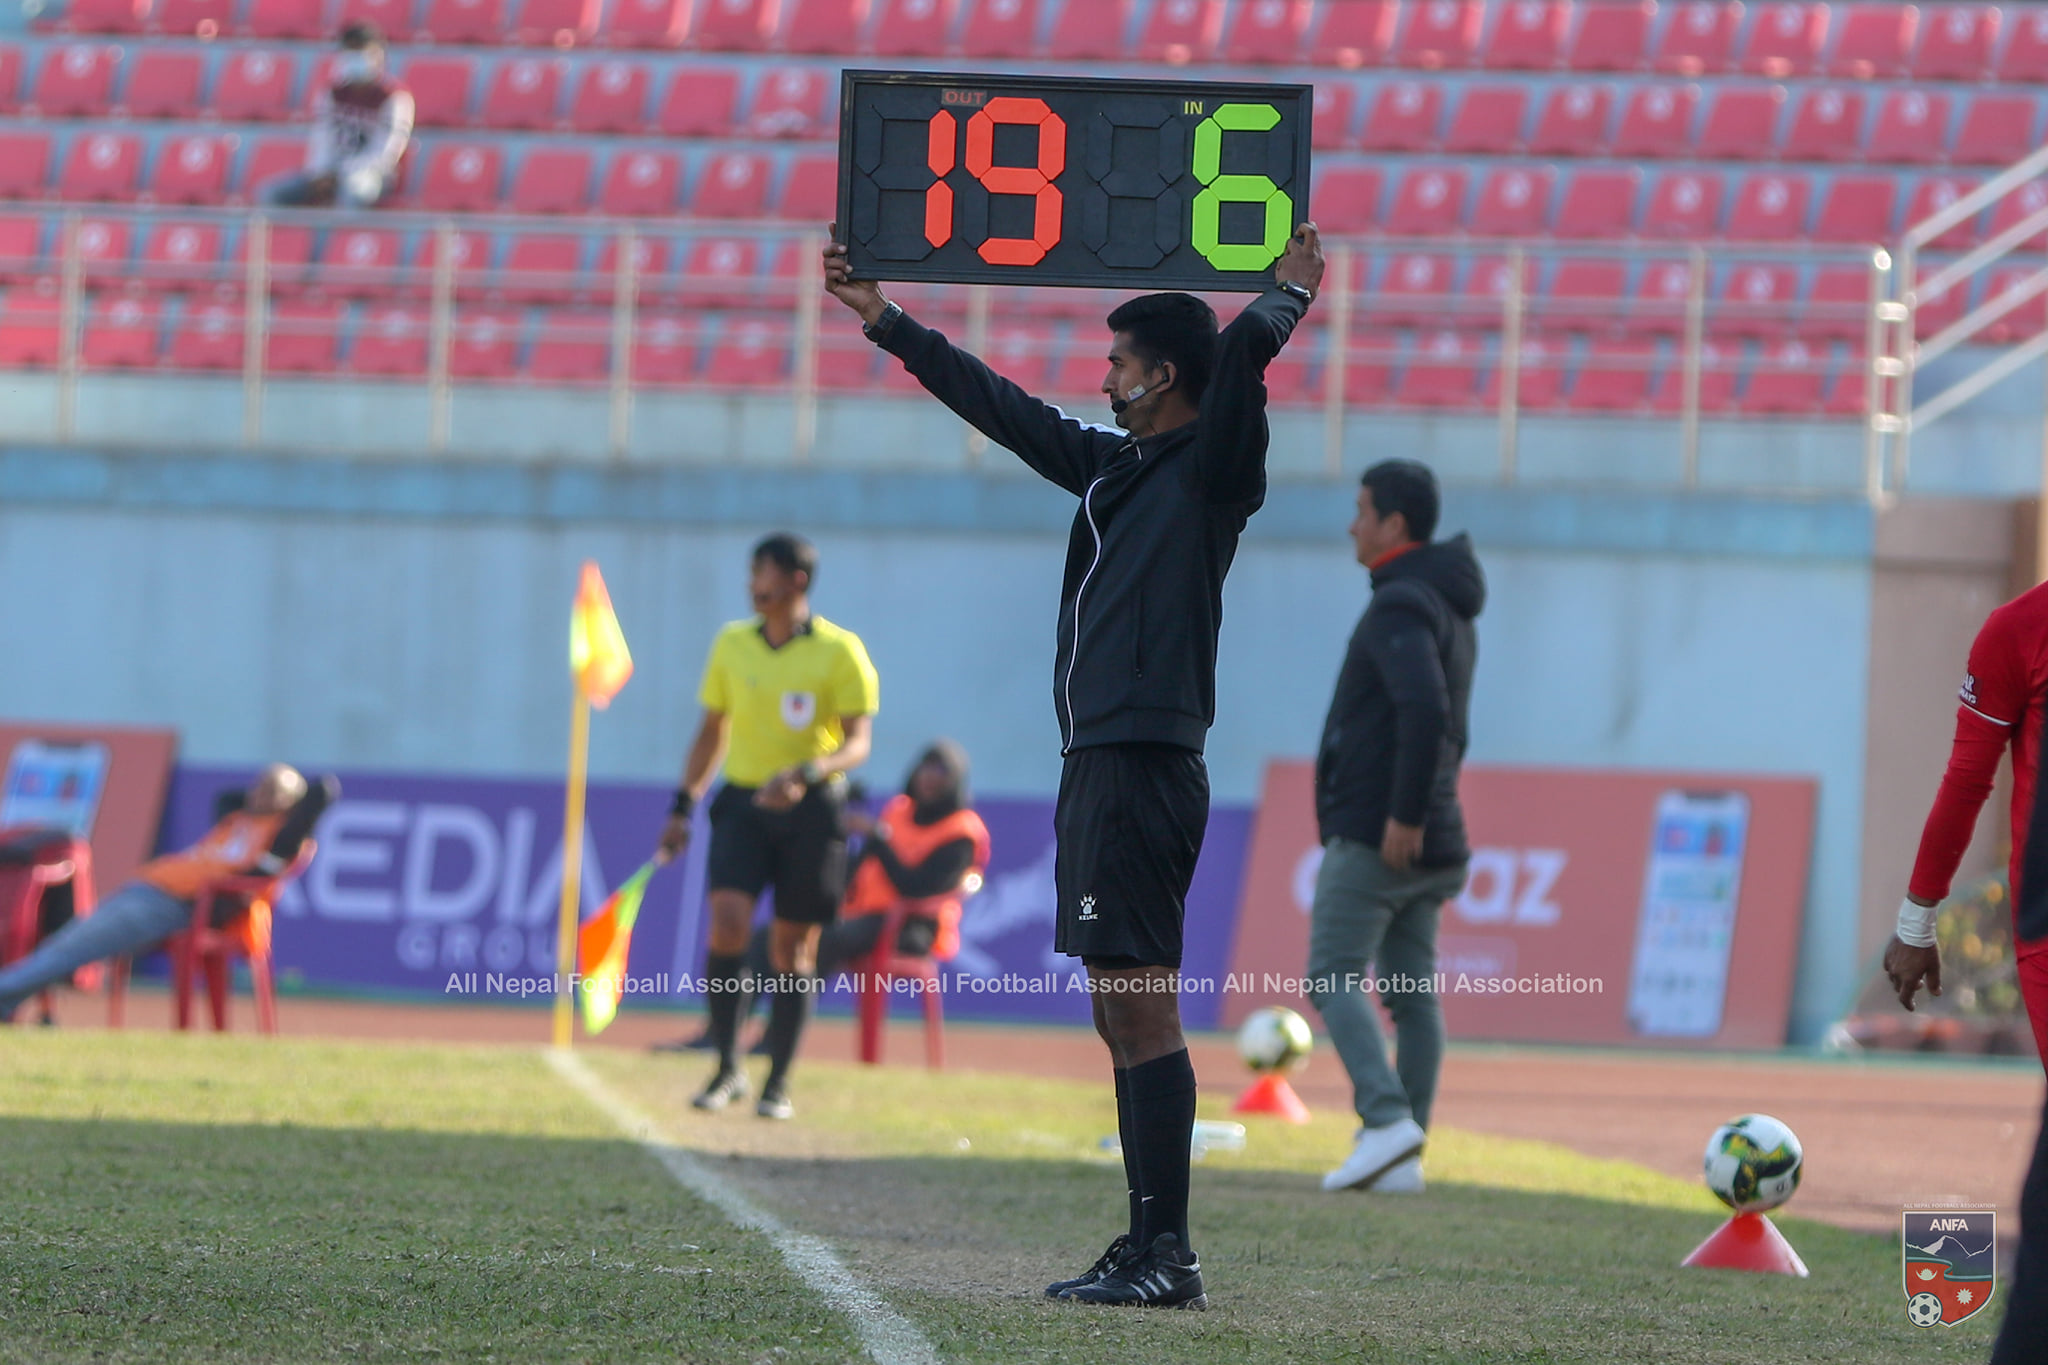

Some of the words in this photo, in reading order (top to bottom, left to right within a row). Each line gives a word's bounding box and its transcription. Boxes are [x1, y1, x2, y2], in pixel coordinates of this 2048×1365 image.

[945, 91, 984, 104] OUT
[1184, 101, 1203, 115] IN
[925, 97, 1067, 266] 19
[1191, 103, 1294, 272] 6
[276, 801, 611, 924] EDIA
